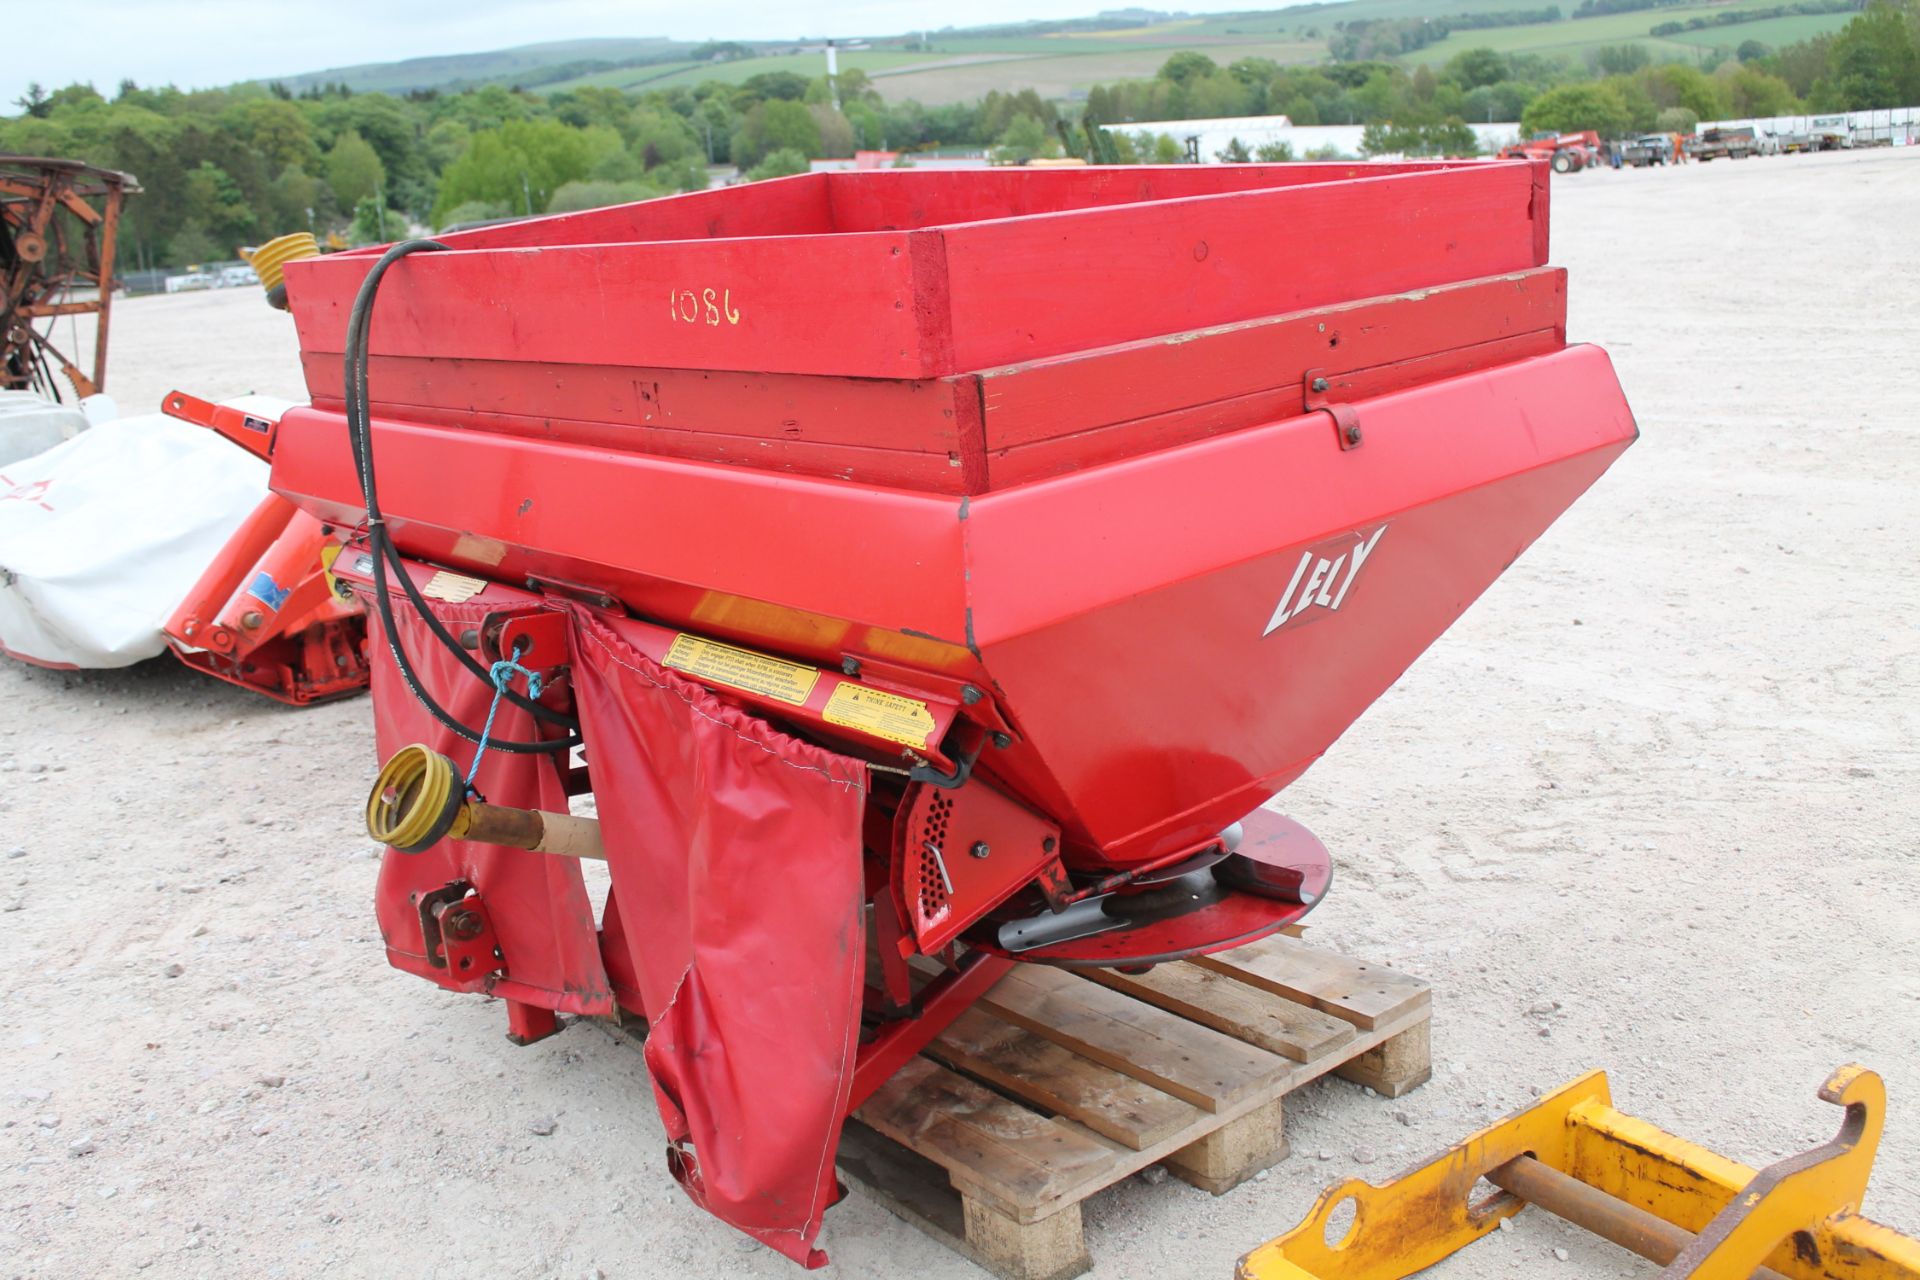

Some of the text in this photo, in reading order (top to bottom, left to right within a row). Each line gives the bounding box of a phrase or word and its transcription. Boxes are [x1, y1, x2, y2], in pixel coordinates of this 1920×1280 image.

[671, 287, 740, 327] 1086
[1261, 524, 1388, 637] LELY
[865, 696, 907, 712] THINK SAFETY
